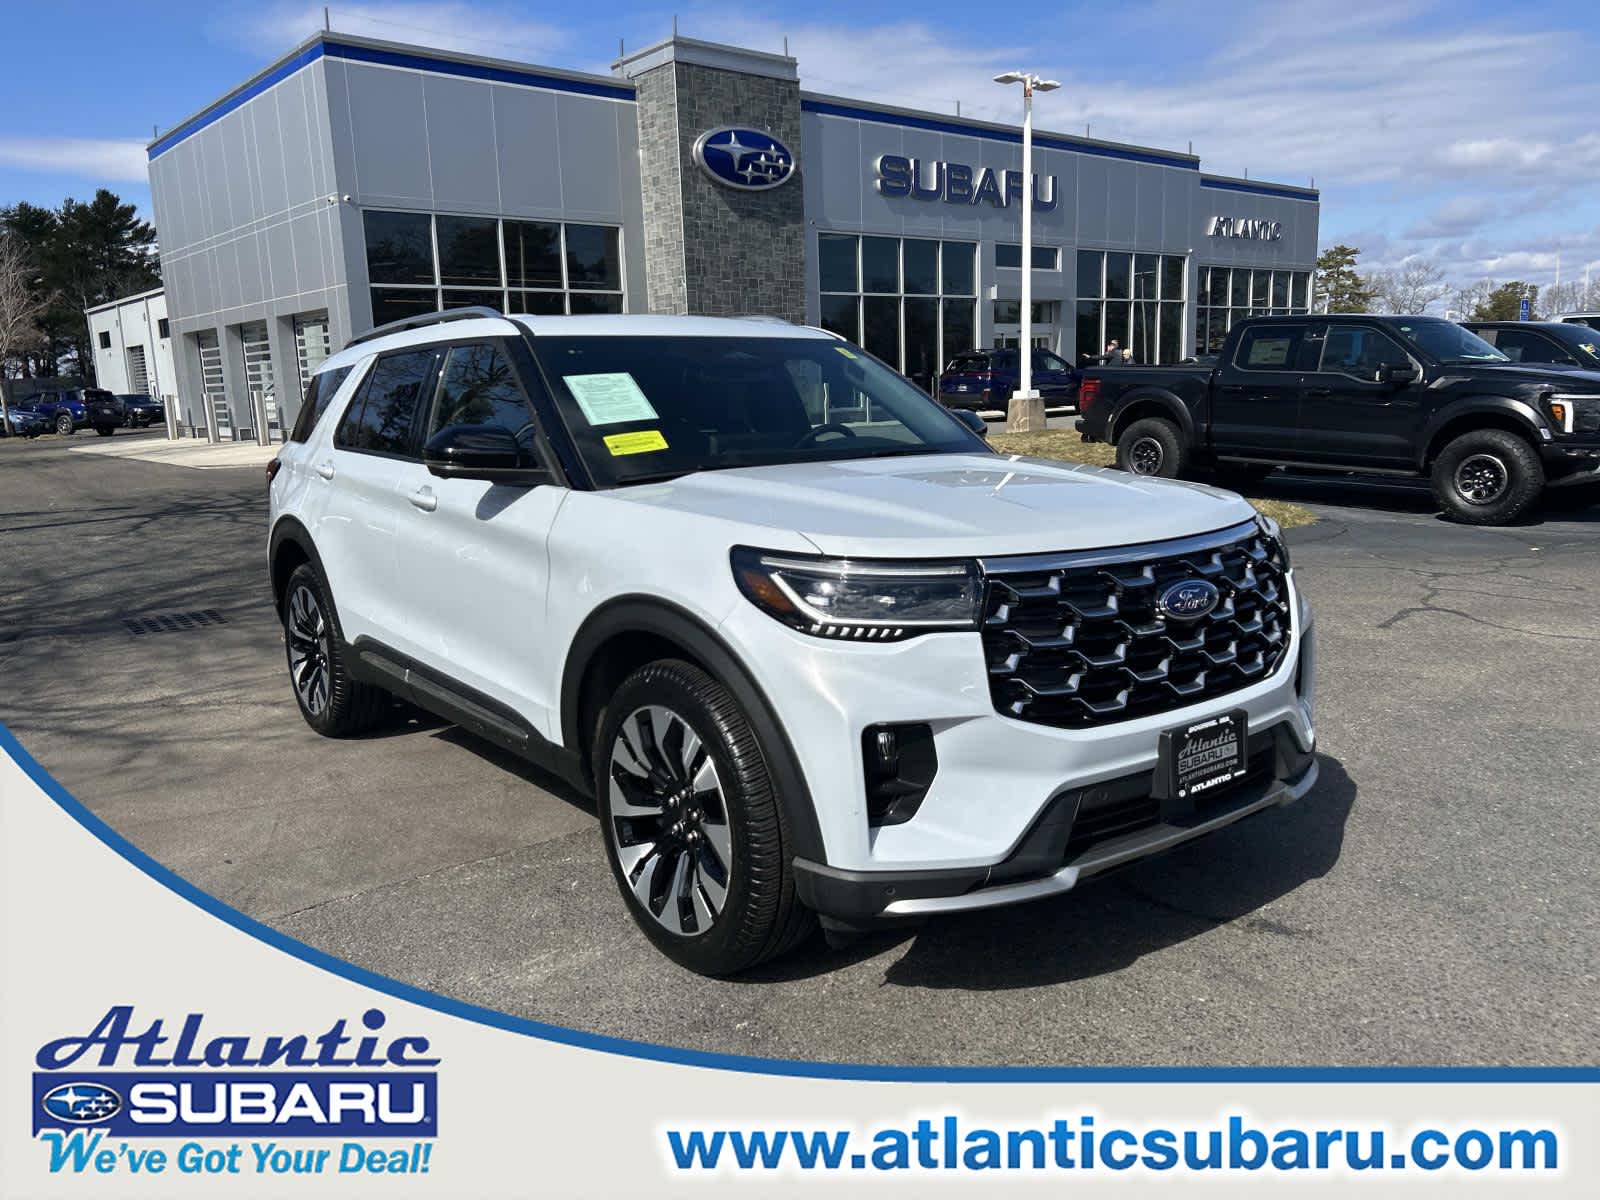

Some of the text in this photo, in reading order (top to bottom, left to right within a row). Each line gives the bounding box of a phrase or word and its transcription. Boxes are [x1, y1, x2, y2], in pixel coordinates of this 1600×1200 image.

[875, 154, 1059, 211] SUBARU
[1207, 216, 1281, 240] ATLANTIC
[1174, 588, 1209, 611] Ford
[1178, 728, 1238, 760] Atlantic
[1179, 745, 1225, 770] SUBARU
[1190, 773, 1232, 794] ATLANTIC
